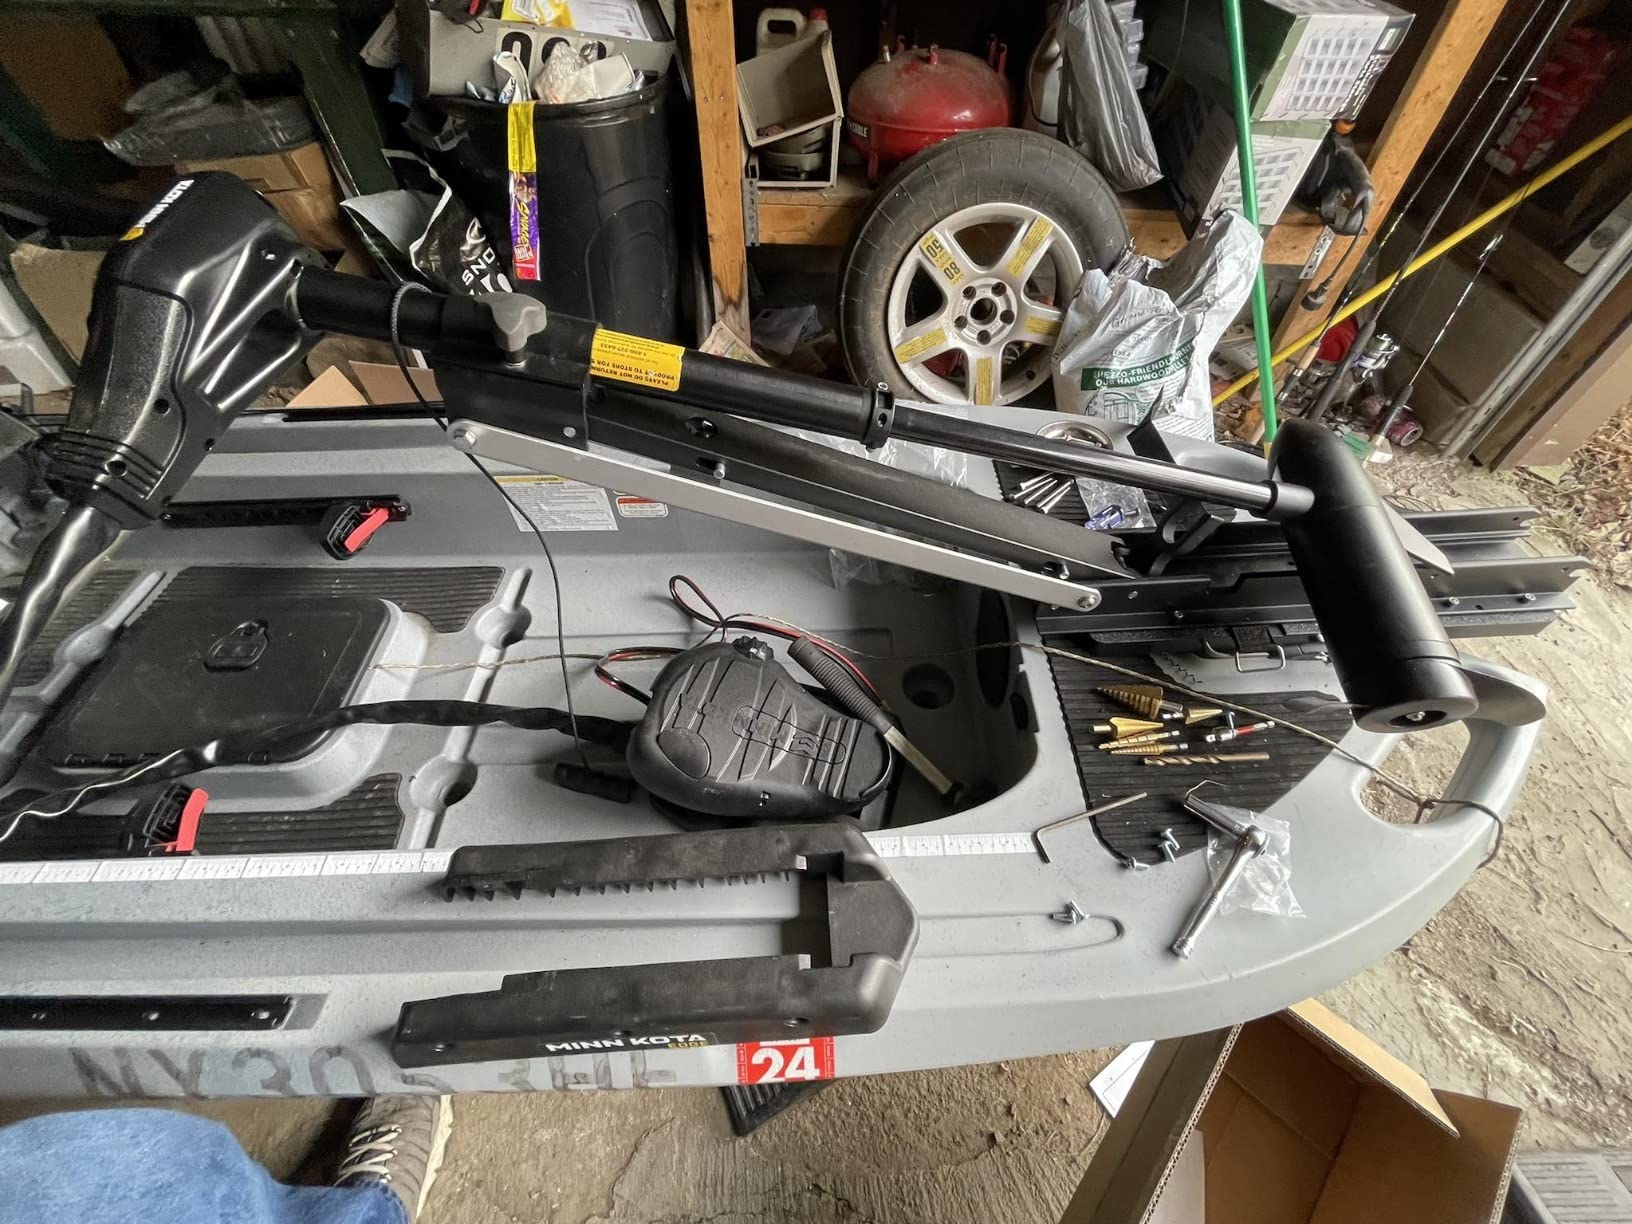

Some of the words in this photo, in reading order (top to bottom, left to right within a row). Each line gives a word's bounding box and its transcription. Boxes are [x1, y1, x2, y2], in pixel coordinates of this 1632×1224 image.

[926, 239, 944, 258] 50
[943, 261, 961, 281] 80
[545, 1039, 624, 1052] MINN
[629, 1034, 706, 1046] KOTA
[751, 1045, 820, 1084] 24
